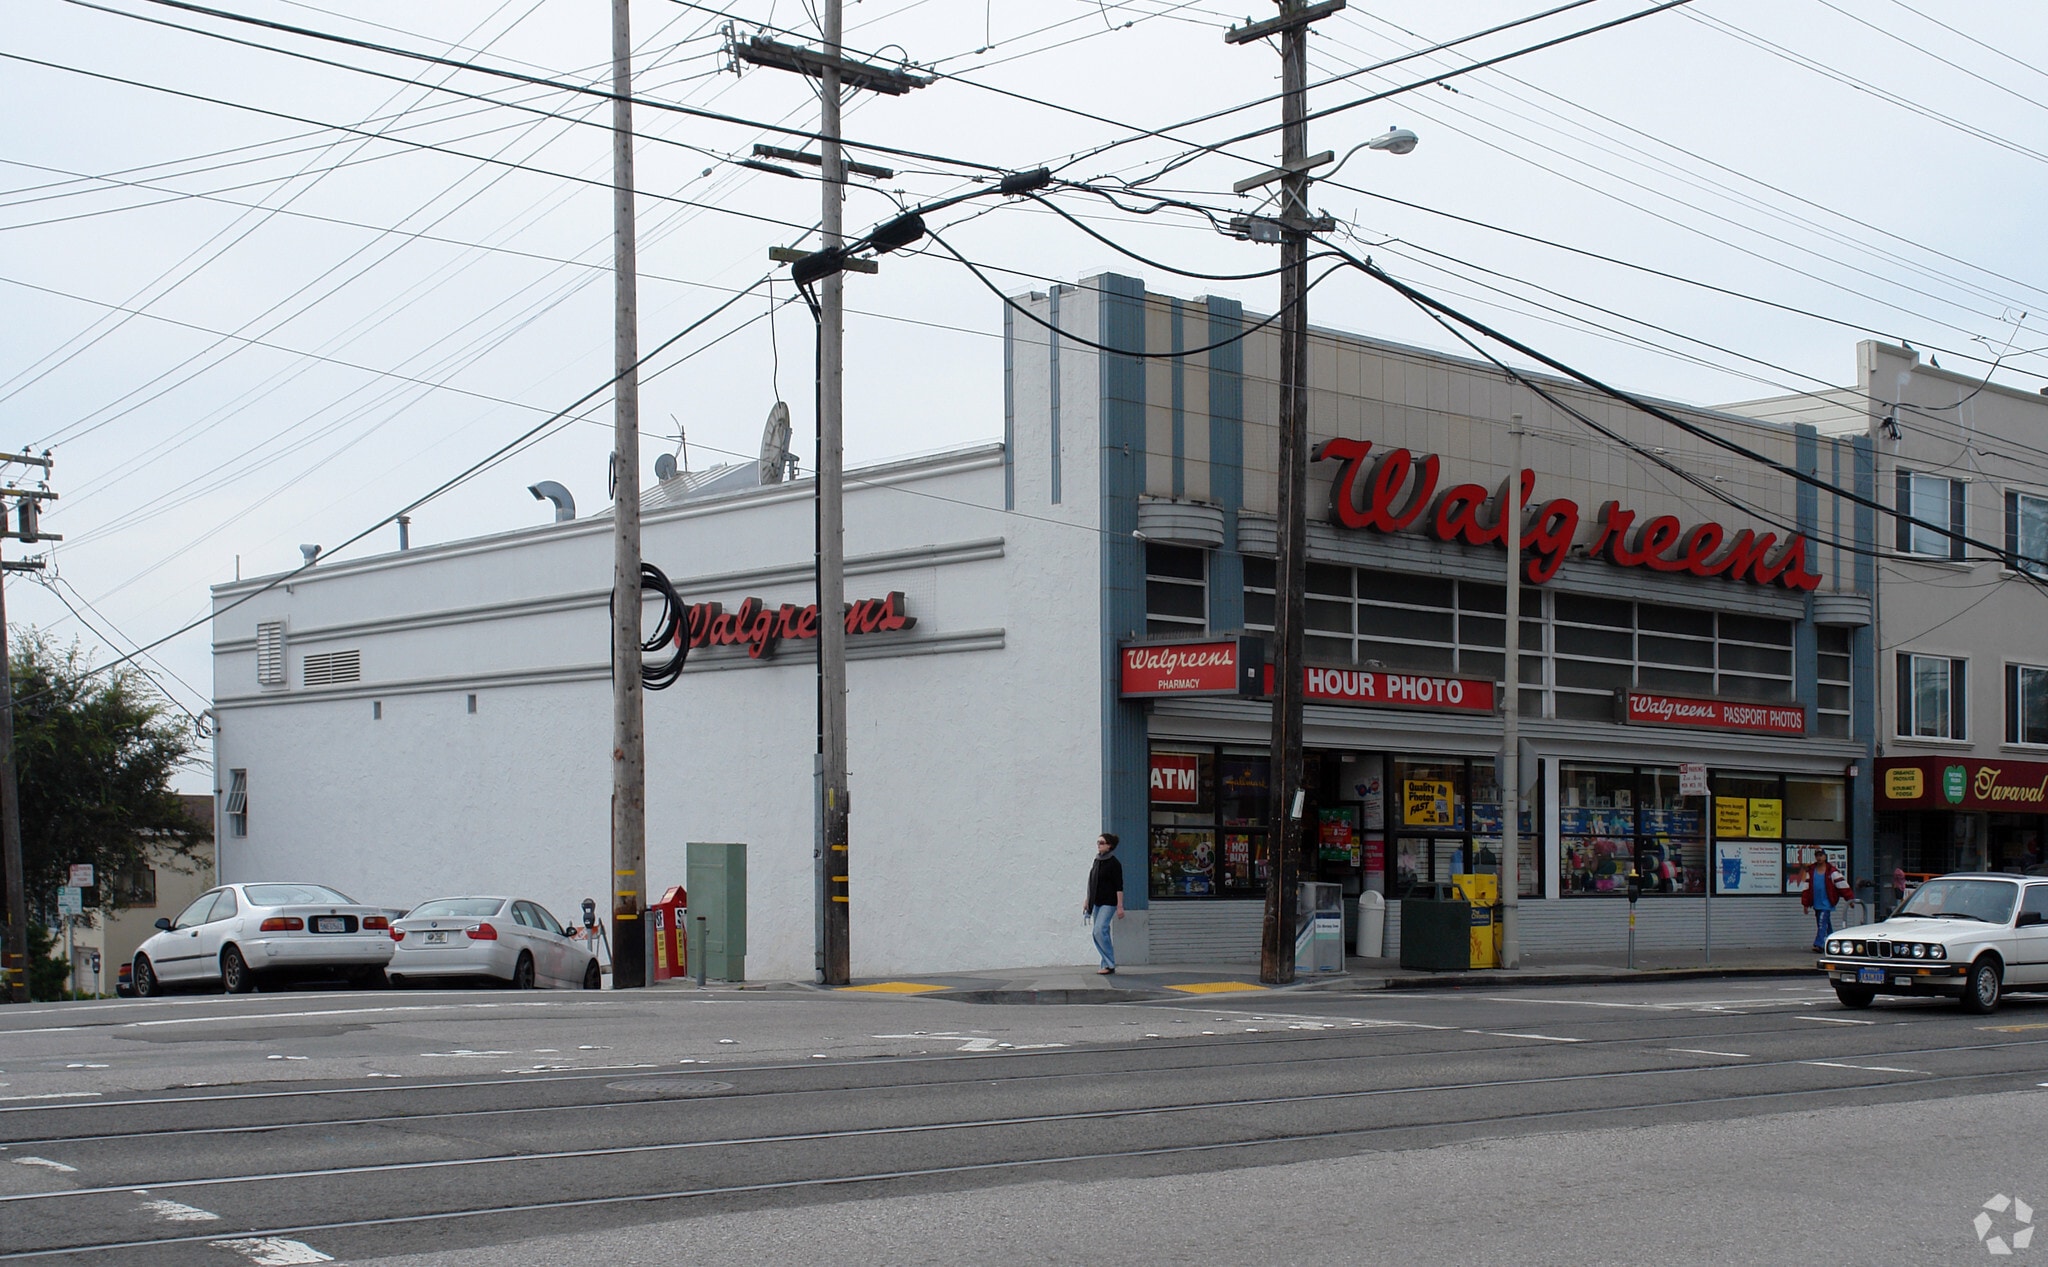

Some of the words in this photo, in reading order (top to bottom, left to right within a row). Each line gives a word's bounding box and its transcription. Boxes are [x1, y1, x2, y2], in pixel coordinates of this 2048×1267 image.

[1311, 437, 1823, 591] Walgreens
[669, 591, 911, 660] Walgrens
[1127, 646, 1234, 676] Walgreens
[1157, 678, 1200, 691] PHARMACY
[1308, 668, 1375, 697] HOUR
[1387, 674, 1464, 704] PHOTO
[1630, 696, 1716, 721] Walgreens
[1723, 706, 1767, 726] PASSPORT
[1769, 709, 1802, 729] PHOTOS
[1150, 768, 1195, 791] ATM
[1408, 782, 1435, 794] Quality
[1974, 766, 2048, 802] Taraval
[1408, 792, 1435, 801] Photos
[1410, 802, 1430, 816] FAST
[1232, 842, 1249, 852] HOT
